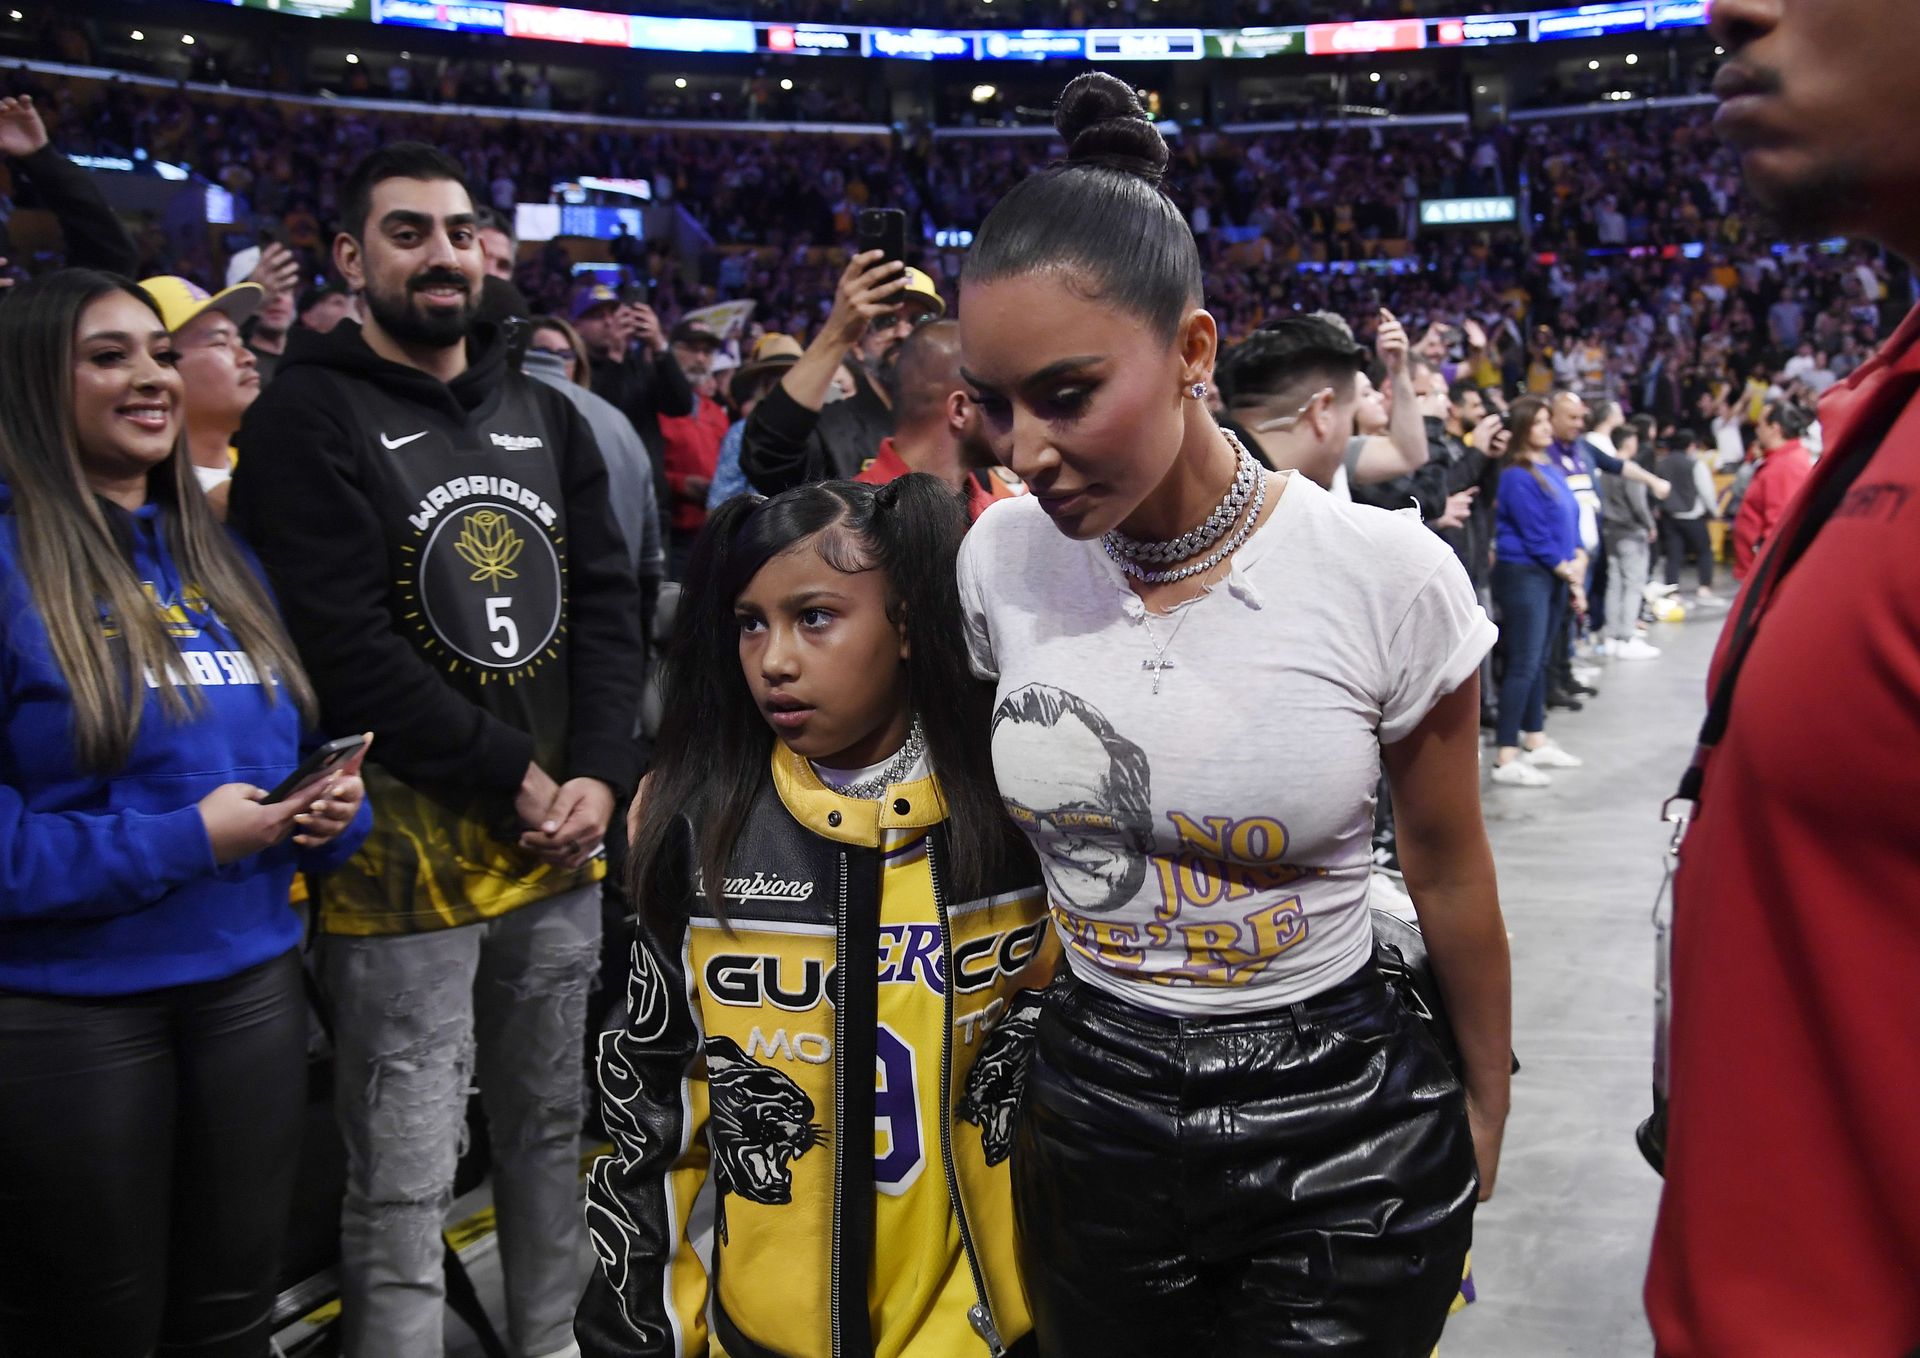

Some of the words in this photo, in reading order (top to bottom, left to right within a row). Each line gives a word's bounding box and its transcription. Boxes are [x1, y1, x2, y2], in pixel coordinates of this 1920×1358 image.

[408, 475, 557, 531] WARRIORS
[485, 596, 520, 658] 5
[1166, 810, 1290, 864] NO
[1148, 853, 1332, 923] JOK
